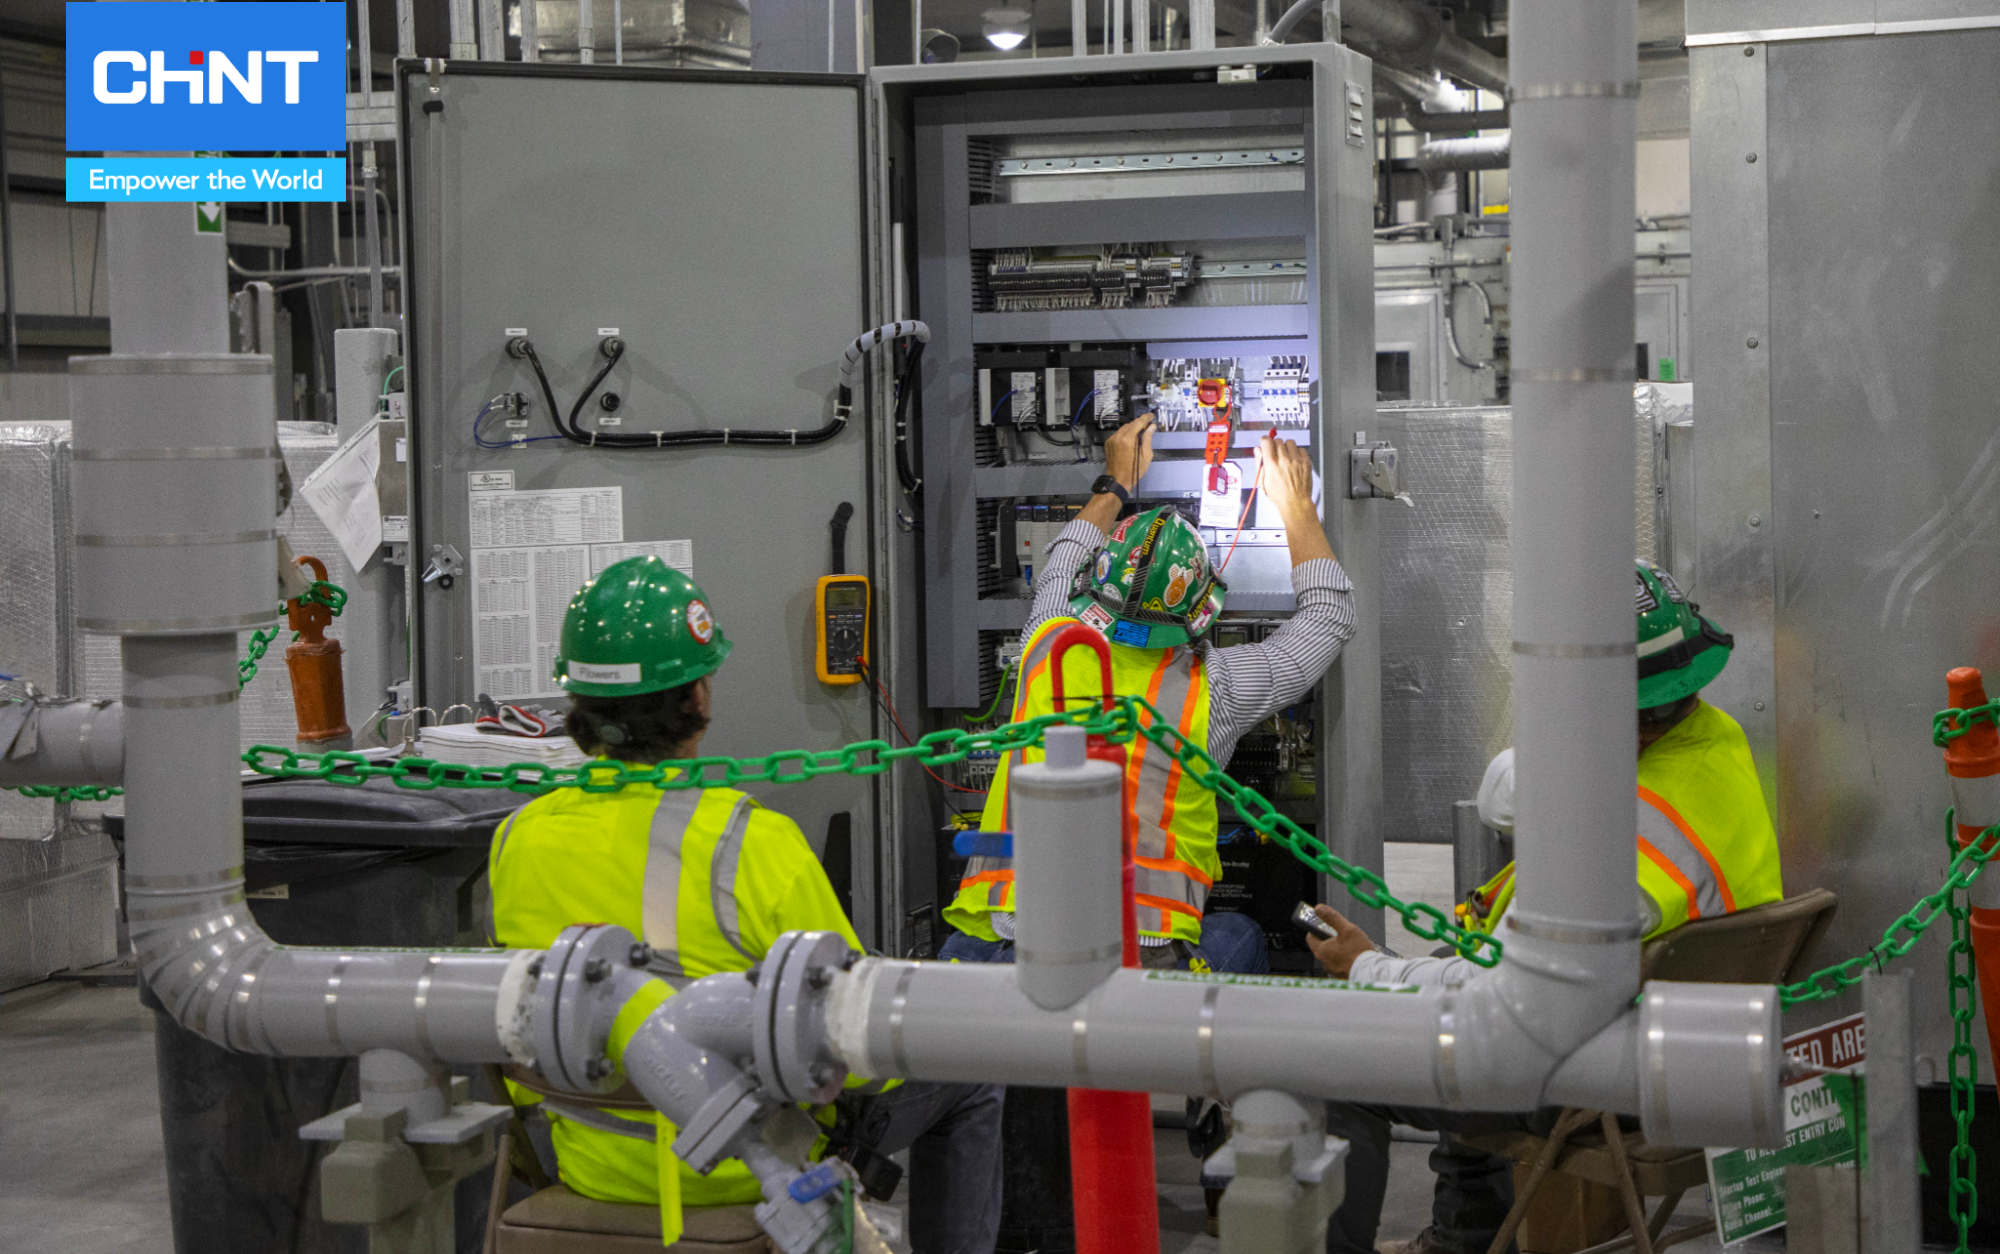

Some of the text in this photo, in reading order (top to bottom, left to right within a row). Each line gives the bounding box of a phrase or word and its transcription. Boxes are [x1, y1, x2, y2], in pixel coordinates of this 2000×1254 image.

[579, 667, 621, 680] Flowers
[1799, 1121, 1826, 1143] ENTRY
[1745, 1174, 1760, 1188] Test
